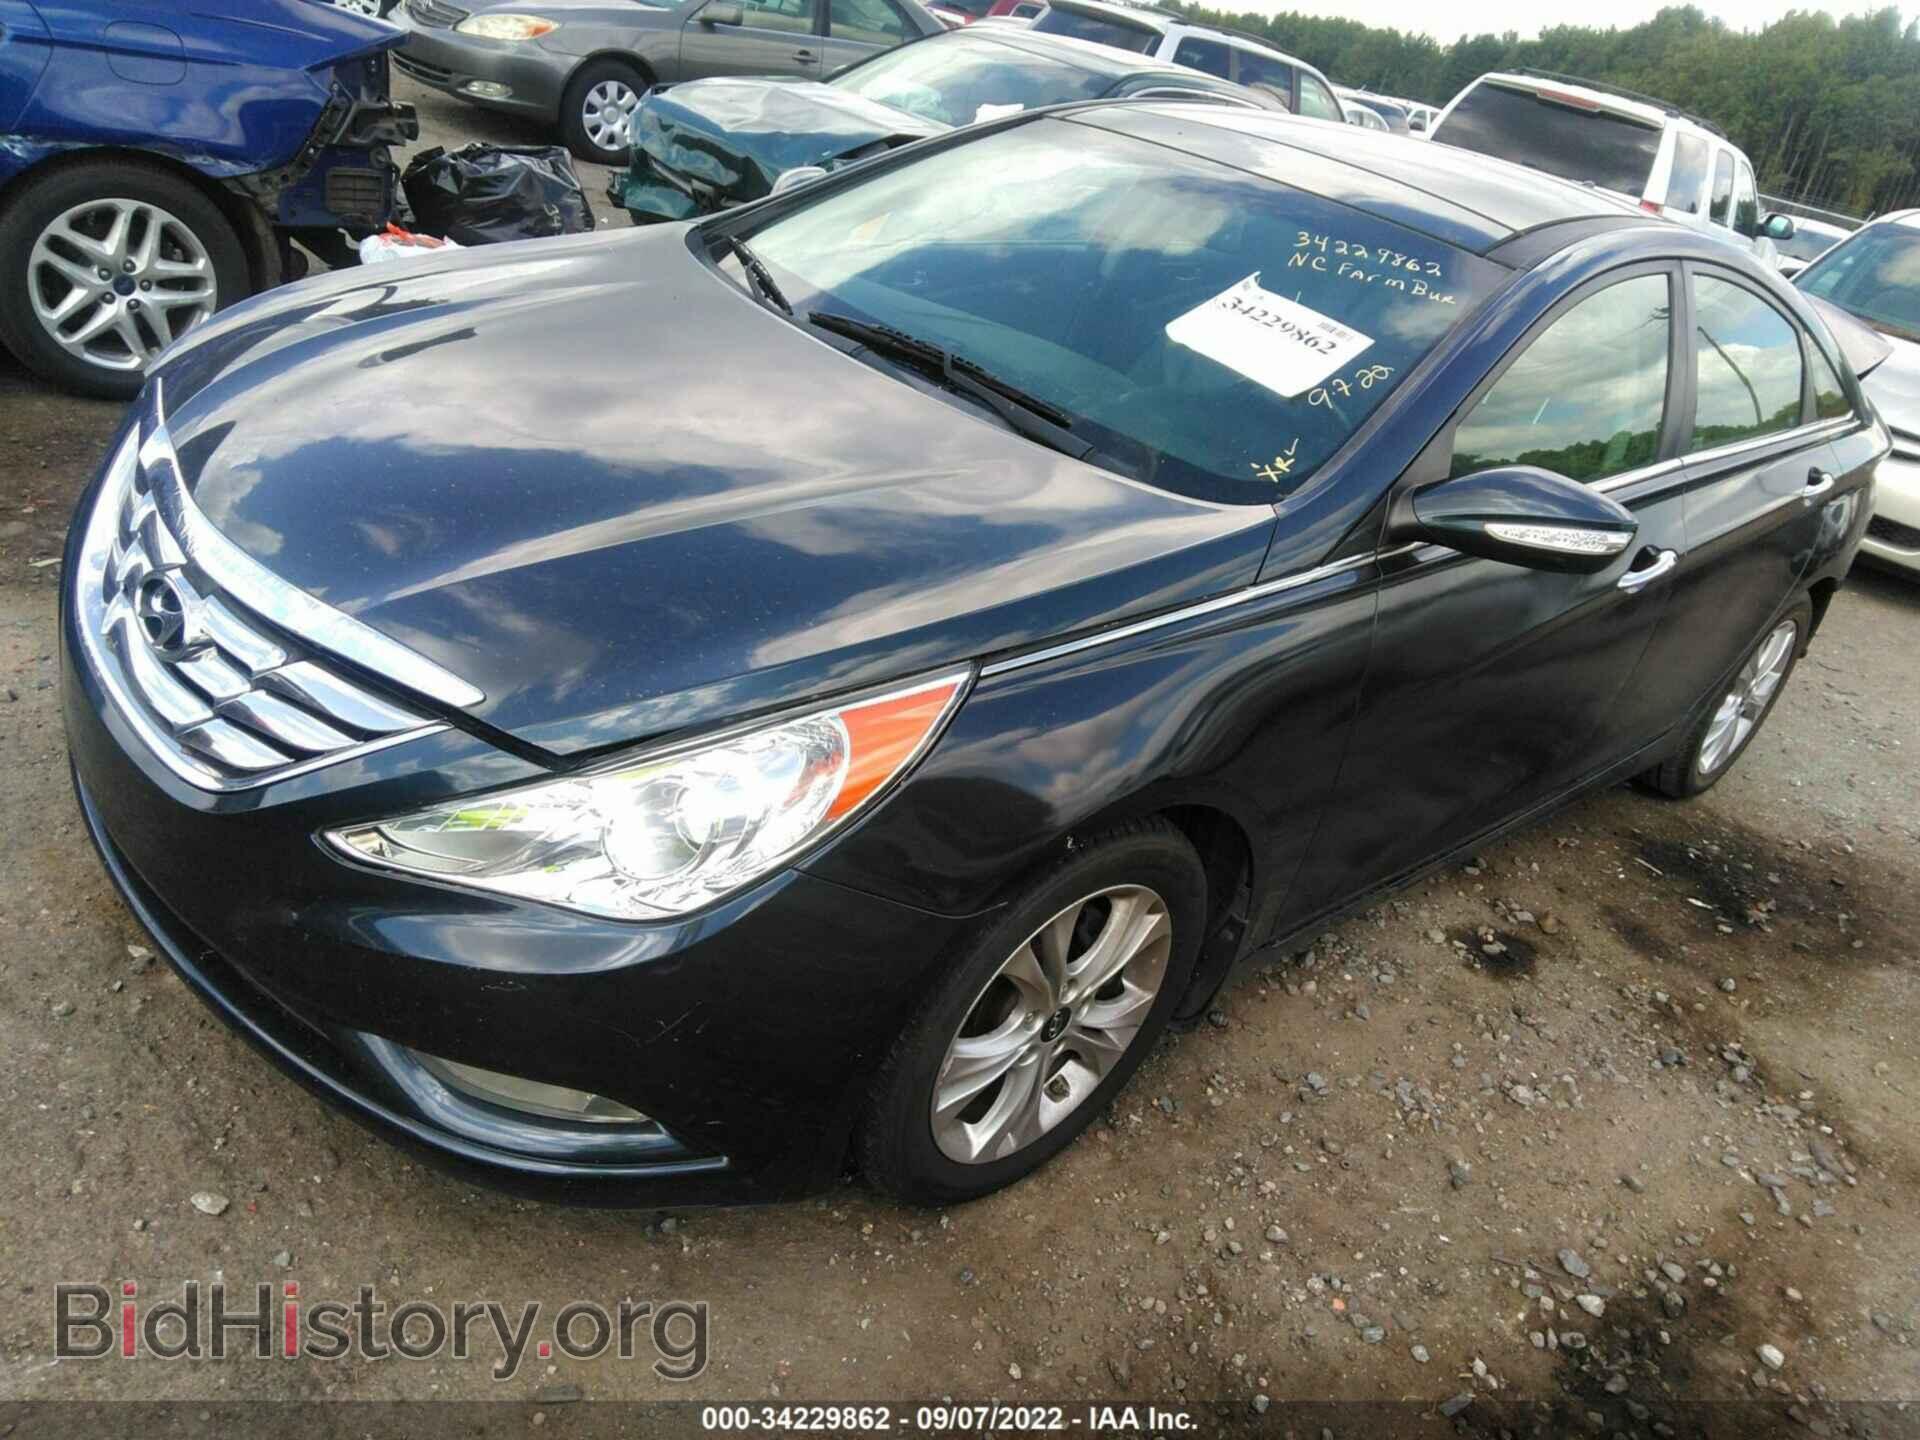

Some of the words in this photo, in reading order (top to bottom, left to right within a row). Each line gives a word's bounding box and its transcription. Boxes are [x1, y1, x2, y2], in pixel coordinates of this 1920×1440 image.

[1287, 251, 1328, 272] NC
[1293, 231, 1442, 277] 34229862
[1221, 296, 1337, 355] 34229862
